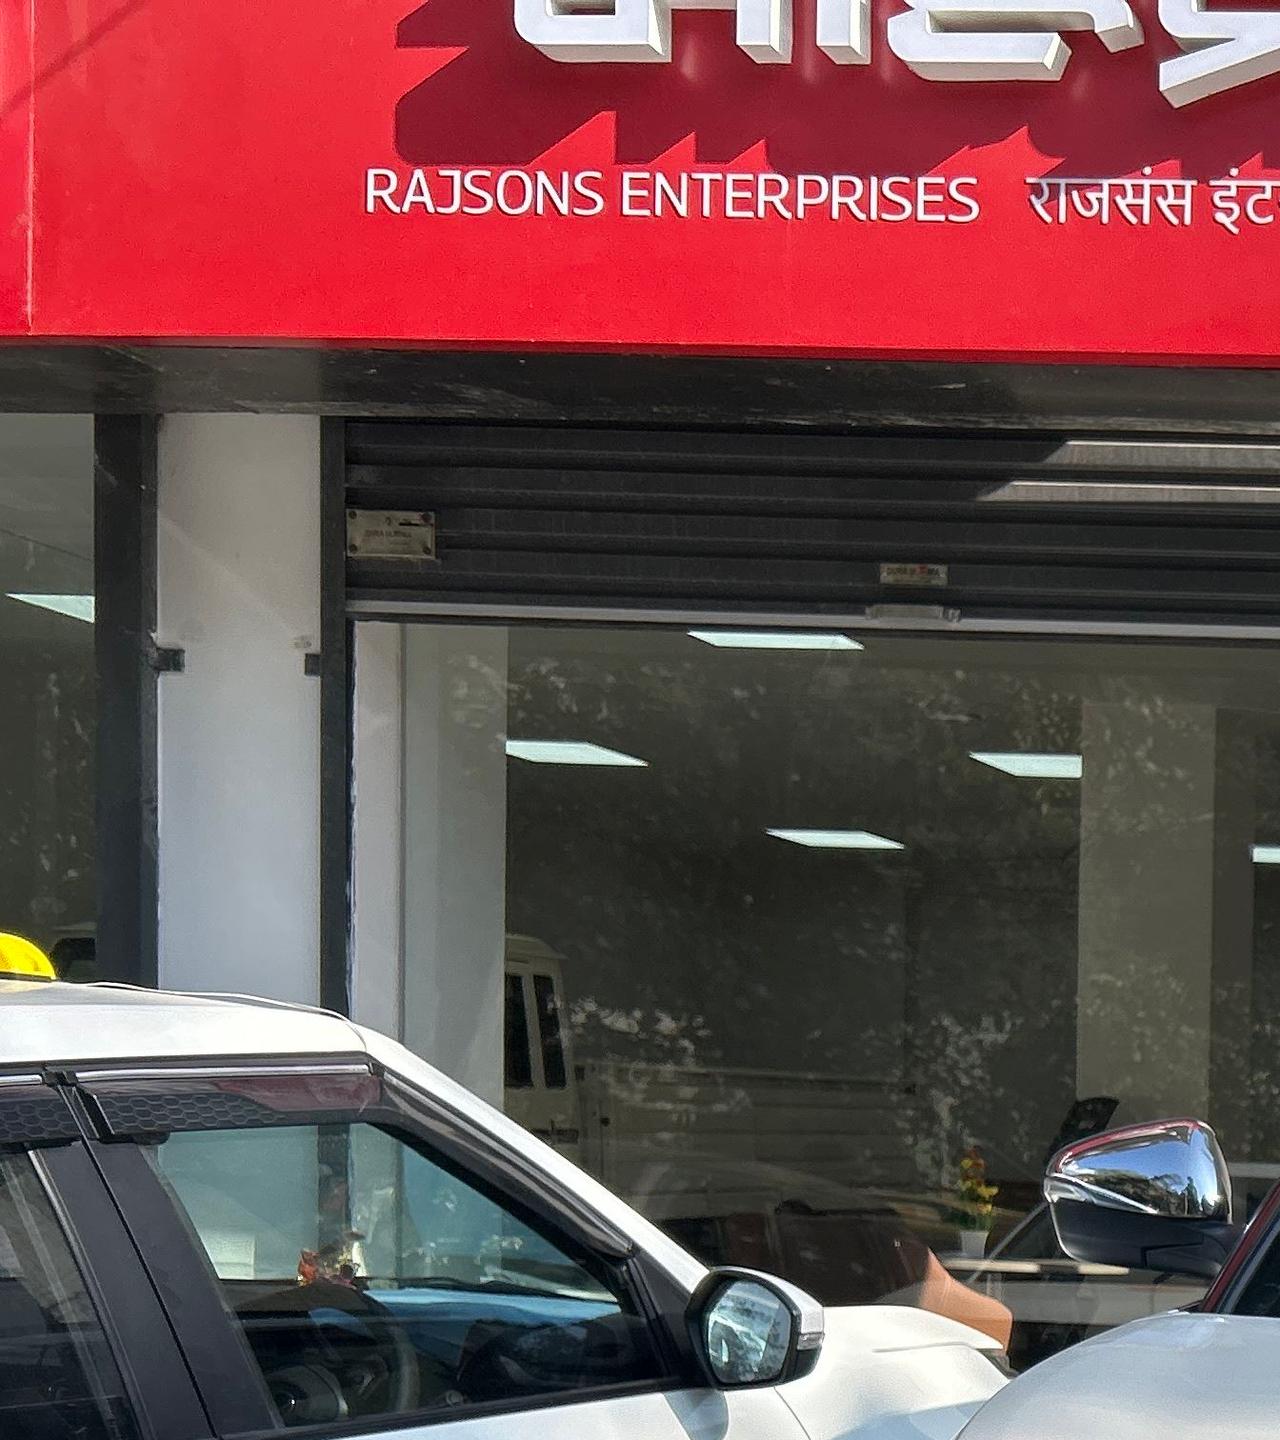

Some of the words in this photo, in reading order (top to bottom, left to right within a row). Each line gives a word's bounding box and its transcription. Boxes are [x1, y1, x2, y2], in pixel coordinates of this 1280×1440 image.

[364, 167, 605, 216] RAJSONS
[620, 171, 980, 224] ENTERPRISES
[1025, 166, 1198, 226] राजसंस
